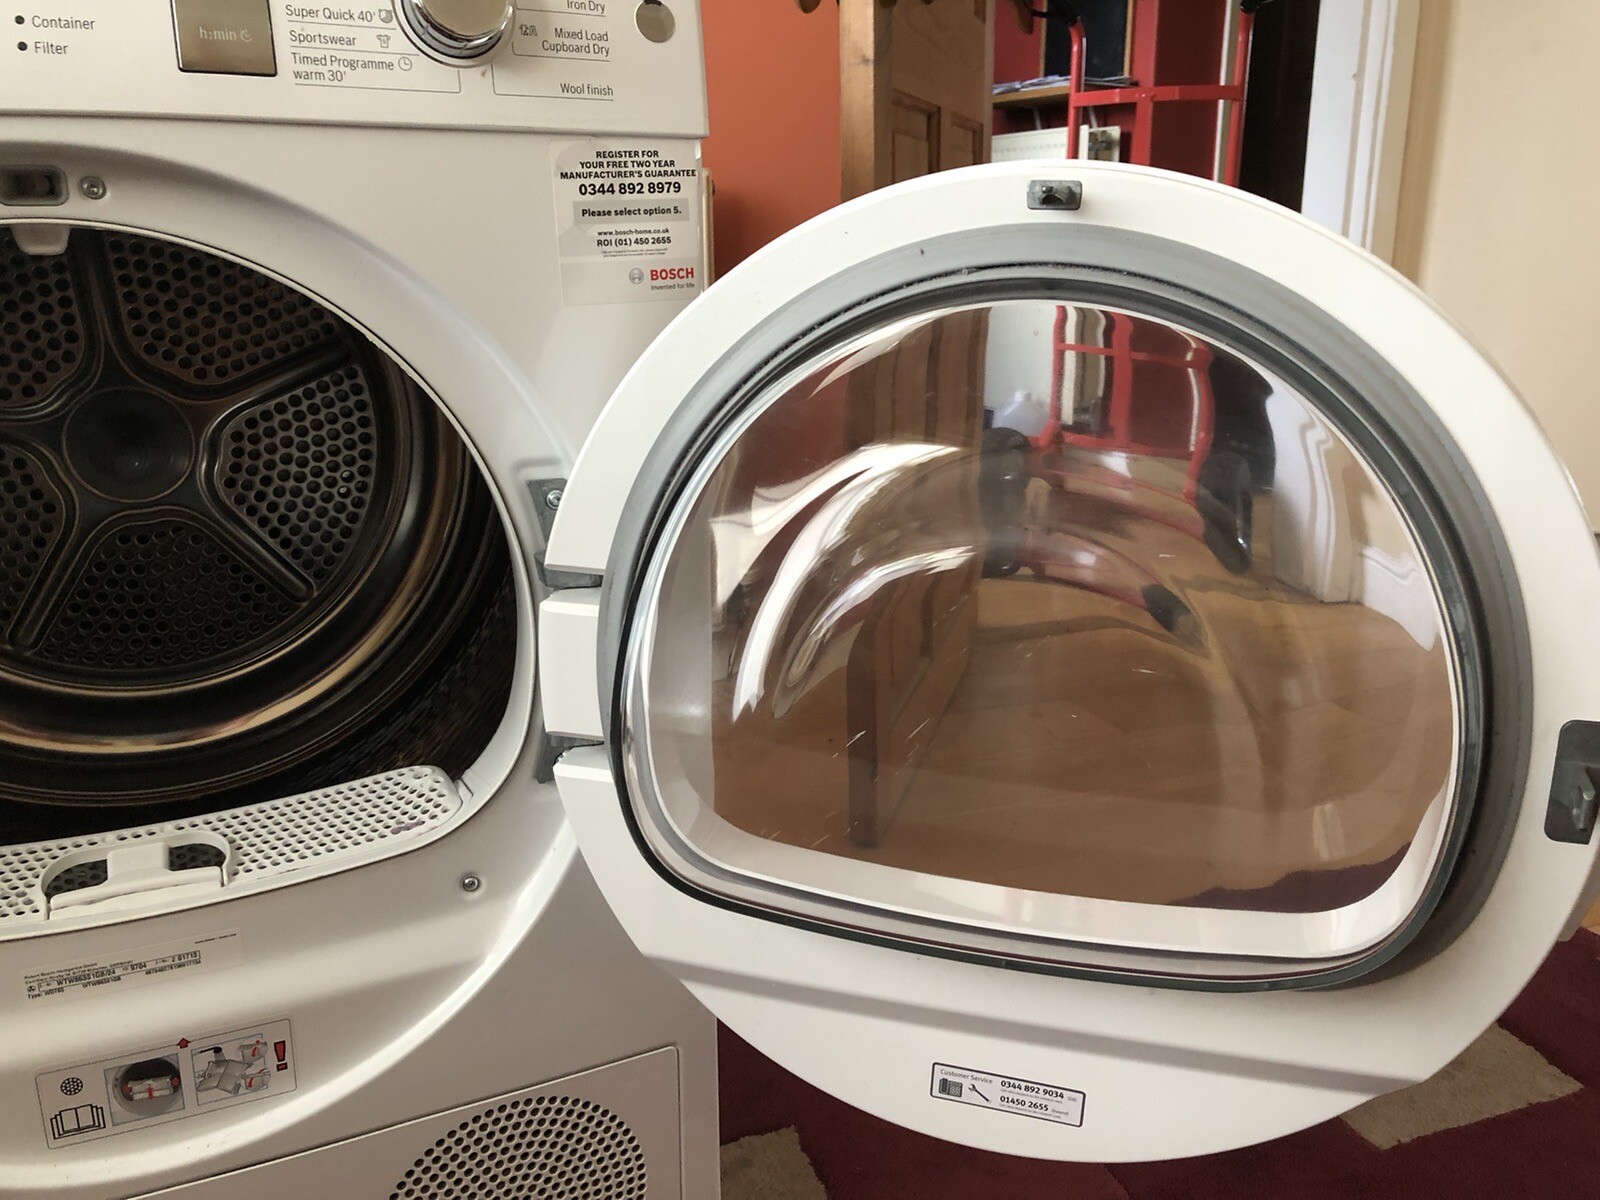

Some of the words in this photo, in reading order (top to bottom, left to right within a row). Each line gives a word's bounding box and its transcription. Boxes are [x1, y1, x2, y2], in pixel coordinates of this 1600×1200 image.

[286, 4, 319, 19] Super
[322, 7, 355, 21] Quick
[358, 10, 376, 23] 40'
[566, 0, 586, 10] Iron
[588, 0, 606, 14] Dry
[32, 15, 95, 30] Container
[200, 26, 237, 41] h:min
[289, 30, 357, 46] Sportswear
[554, 27, 583, 40] Mixed
[585, 30, 609, 42] Load
[34, 41, 69, 55] Filter
[542, 40, 590, 54] Cupboard
[593, 44, 610, 57] Dry
[291, 52, 328, 66] Timed
[330, 55, 394, 71] Programme
[293, 70, 325, 81] warm
[328, 70, 347, 82] 30'
[560, 83, 585, 95] Wool
[586, 84, 614, 96] finish
[596, 150, 640, 159] REGISTER
[642, 150, 659, 158] FOR
[580, 161, 605, 169] YOUR
[606, 161, 628, 169] FREE
[630, 160, 651, 168] TWO
[653, 160, 675, 168] YEAR
[560, 170, 643, 179] MANUFACTURER'S
[645, 169, 697, 178] GUARANTEE
[578, 183, 616, 196] 0344
[618, 182, 644, 195] 892
[647, 182, 682, 194] 8979
[582, 208, 612, 217] Please
[614, 207, 641, 216] select
[643, 206, 672, 216] option
[673, 206, 682, 214] 5.
[597, 228, 670, 236] www.bosch-home.co.uk
[597, 239, 612, 247] ROI
[614, 238, 632, 247] (01)
[634, 237, 650, 245] 450
[651, 236, 671, 244] 2655
[650, 267, 694, 281] BOSCH
[651, 283, 676, 291] Invented
[677, 282, 685, 290] for
[130, 962, 147, 972] 9704
[940, 1068, 970, 1080] Customer
[970, 1075, 994, 1085] Service
[1000, 1079, 1022, 1091] 0344
[1024, 1084, 1040, 1095] 892
[1042, 1088, 1065, 1100] 9034
[1000, 1095, 1026, 1107] 01450
[1028, 1100, 1049, 1112] 2655
